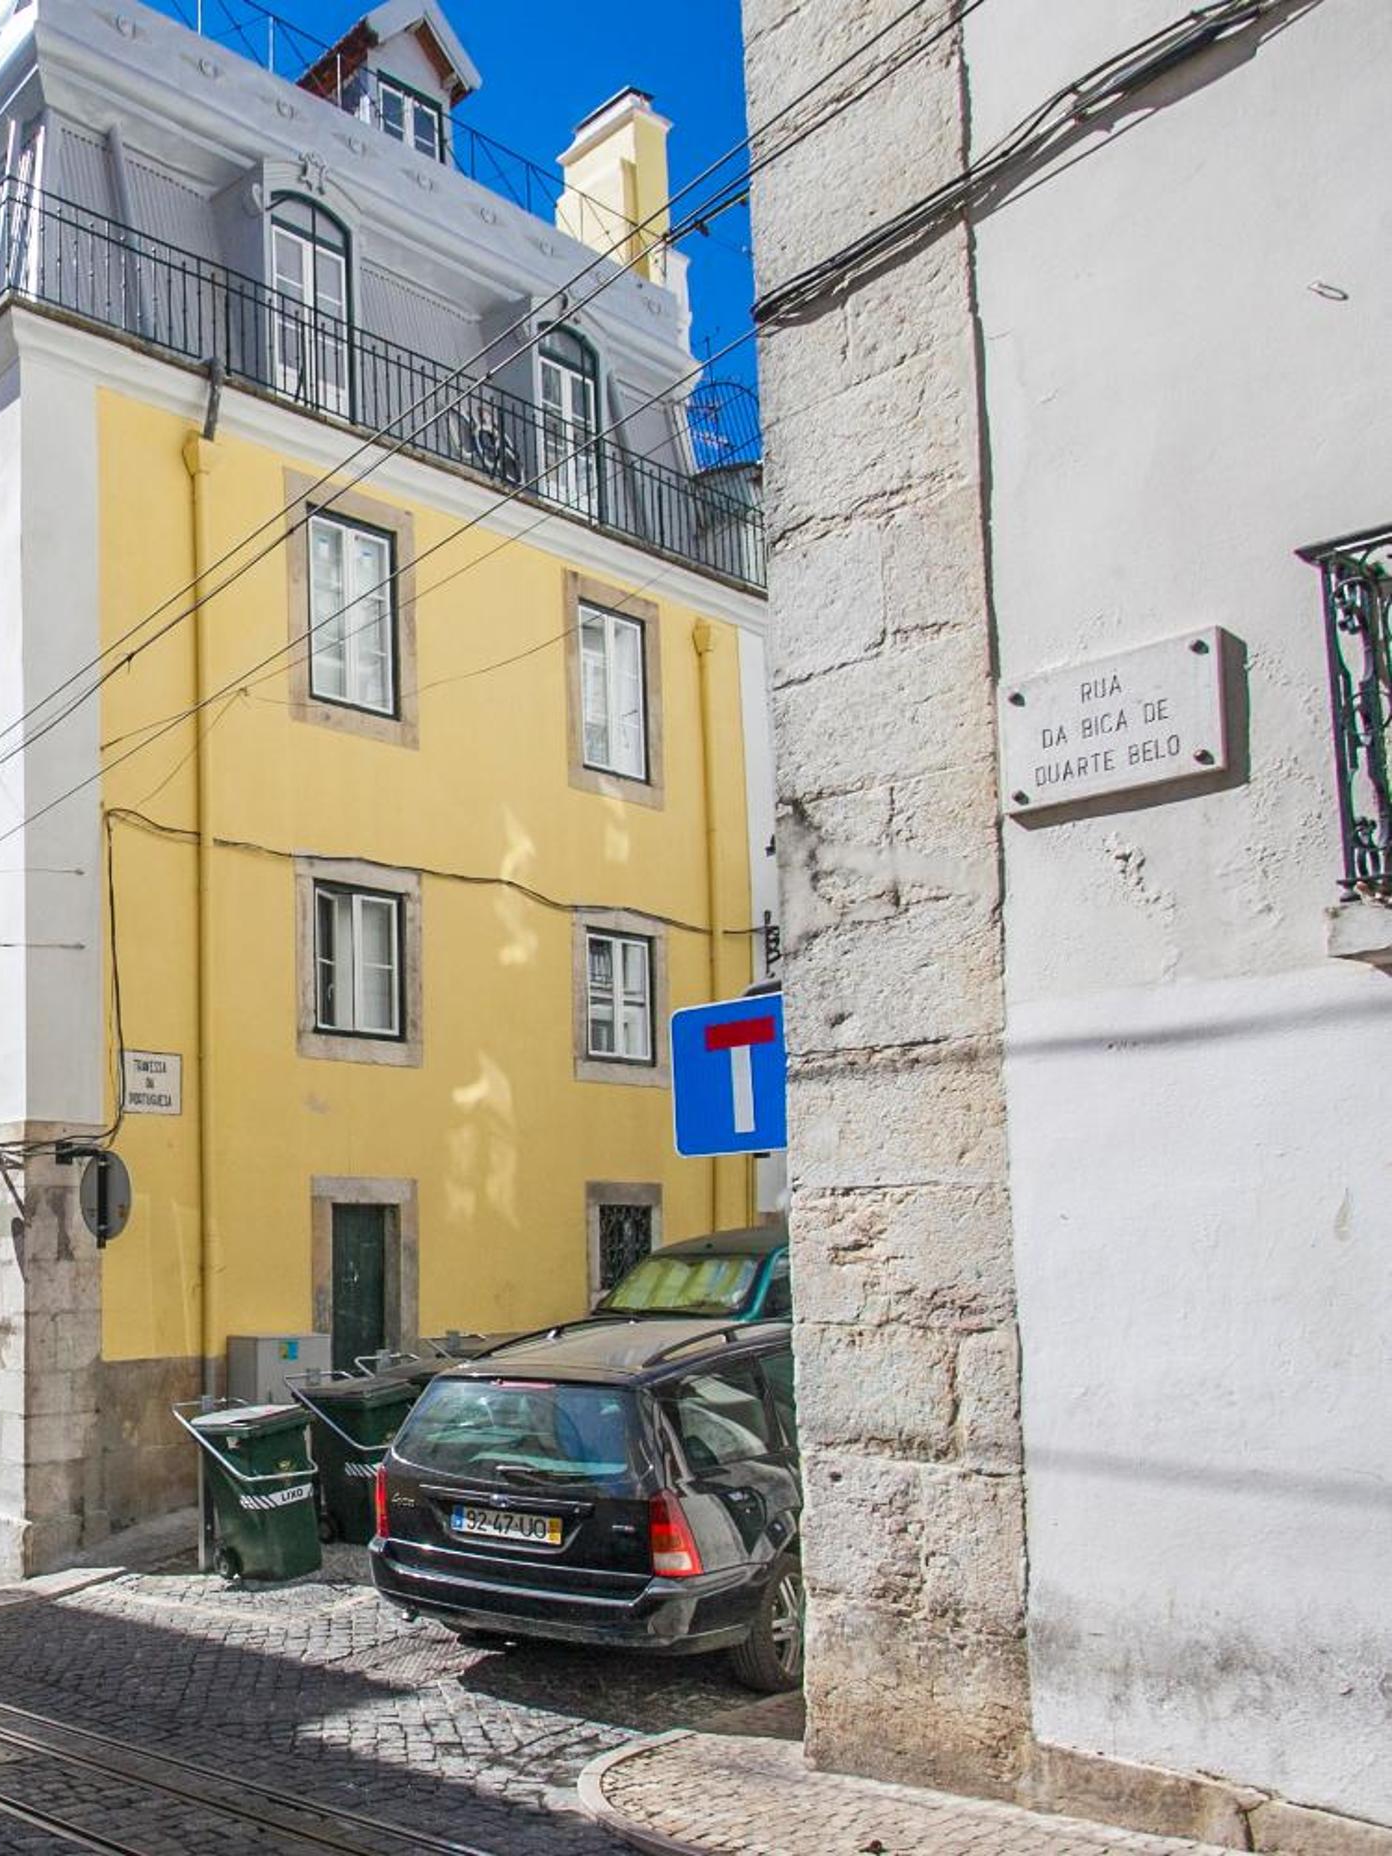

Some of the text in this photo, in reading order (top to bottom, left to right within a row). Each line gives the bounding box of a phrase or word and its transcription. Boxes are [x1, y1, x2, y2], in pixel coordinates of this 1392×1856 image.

[1080, 673, 1123, 704] RUA
[1041, 697, 1170, 750] DA BICA DE
[1033, 733, 1182, 788] DUARTE BELO
[280, 1487, 304, 1503] LIXO
